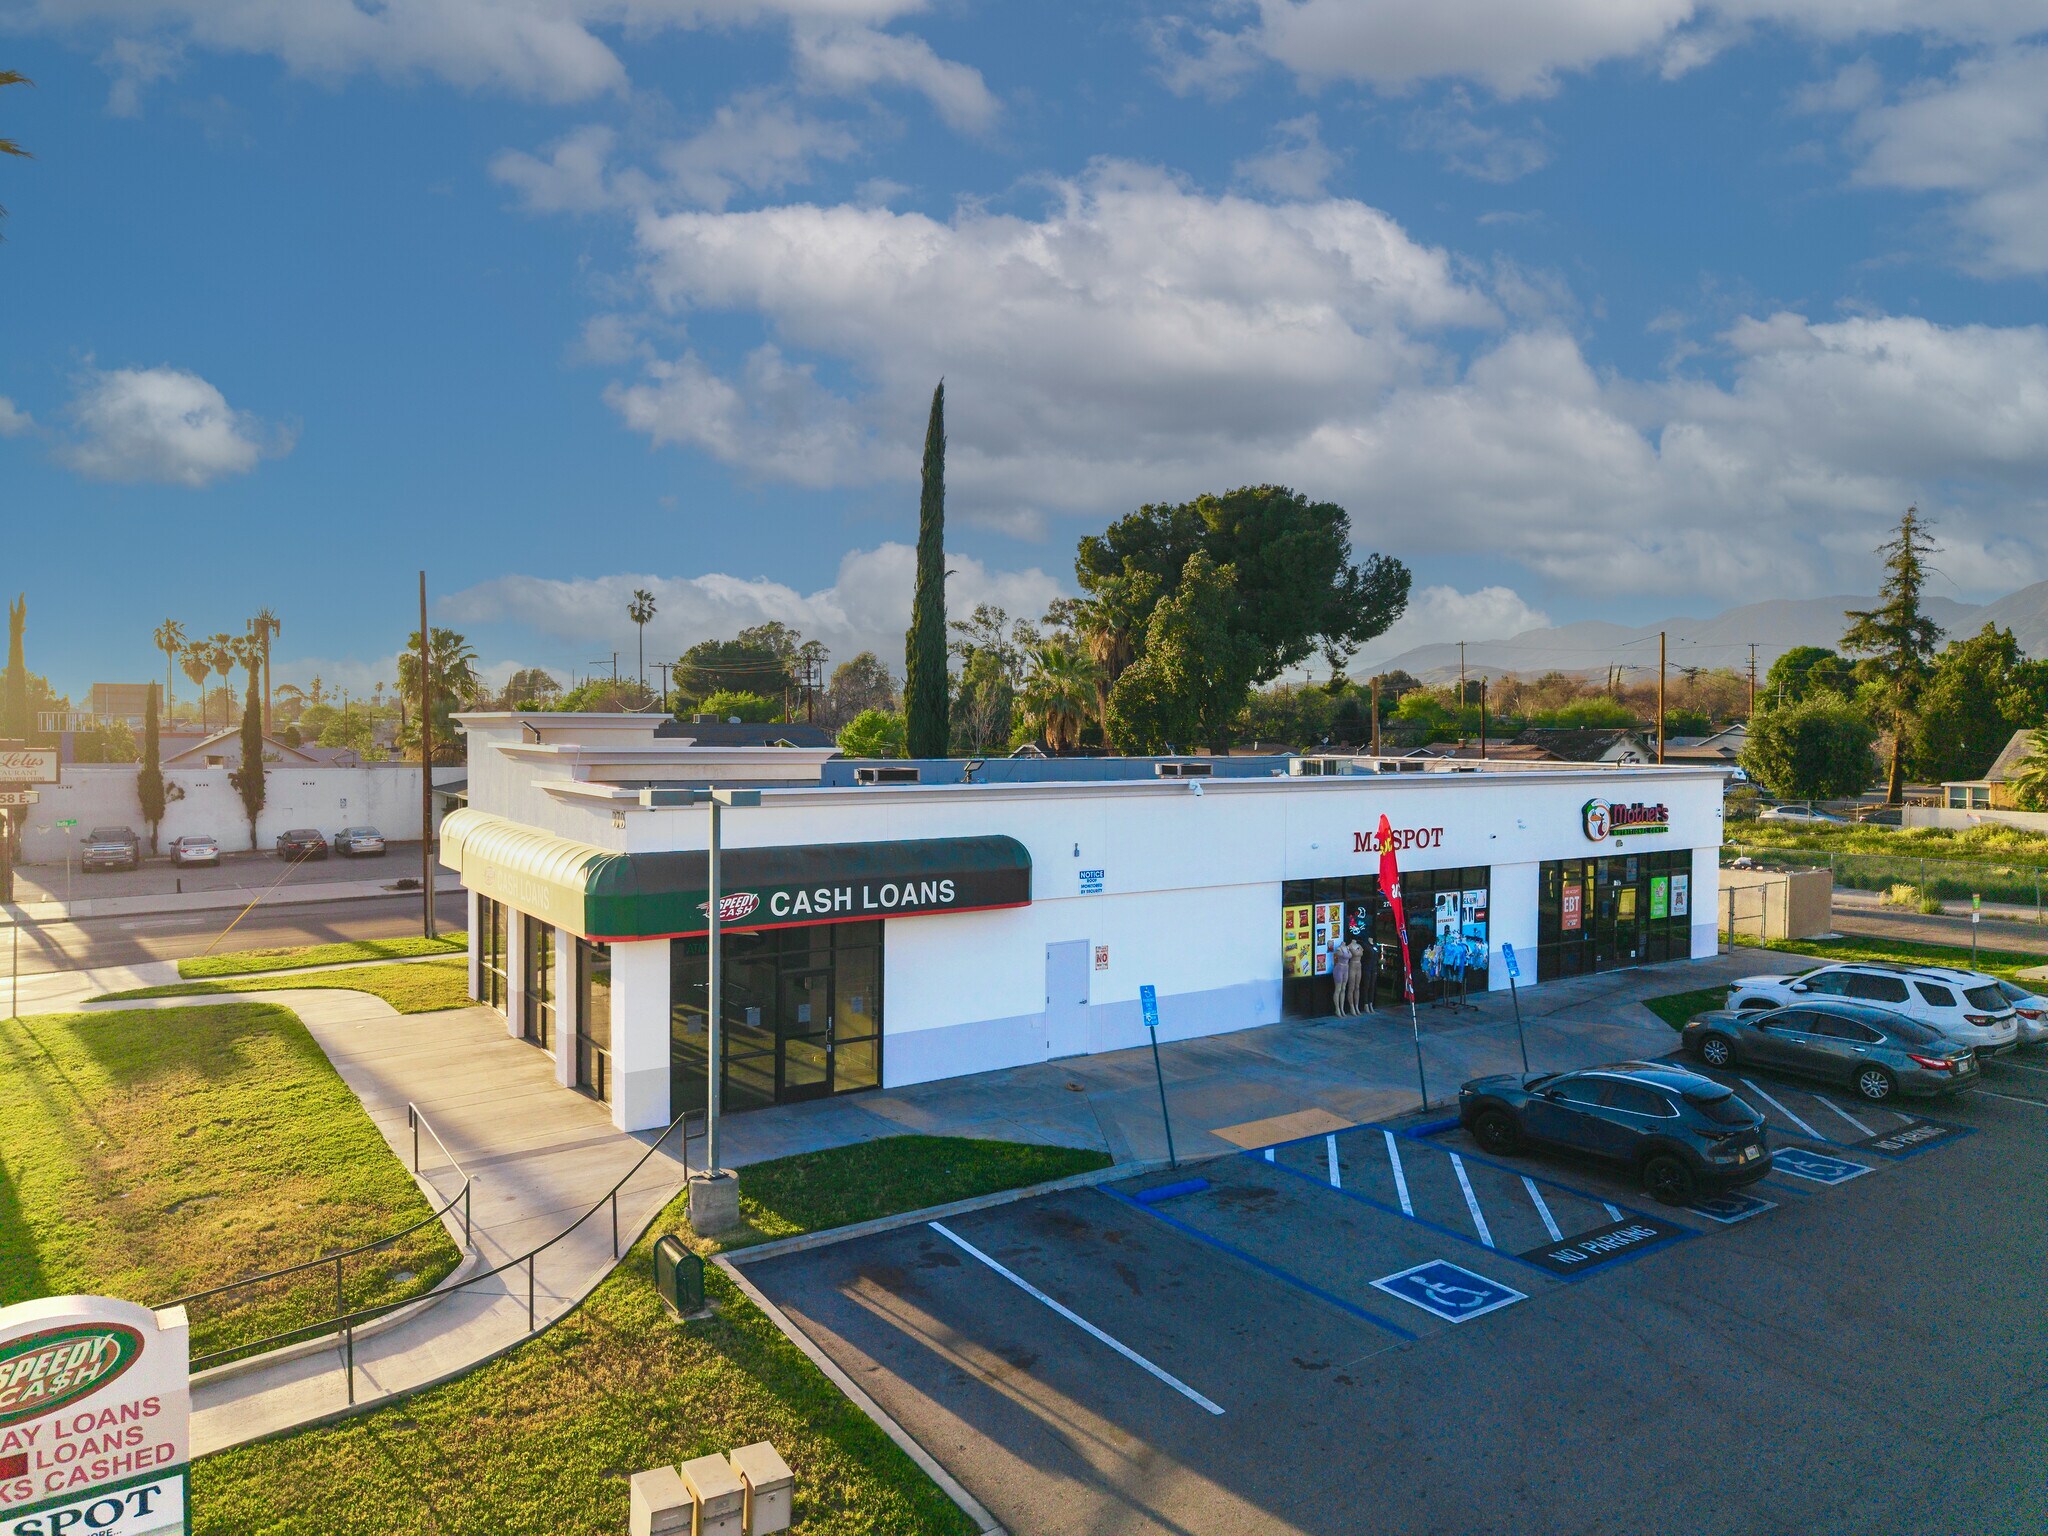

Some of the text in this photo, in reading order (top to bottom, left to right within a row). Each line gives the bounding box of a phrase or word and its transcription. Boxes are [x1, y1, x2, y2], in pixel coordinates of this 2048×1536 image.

[0, 752, 44, 769] Lotus
[1392, 827, 1444, 851] SPOT
[1080, 870, 1104, 879] NOTICE
[520, 876, 551, 910] LOANS
[718, 892, 759, 911] SPEEDY
[770, 879, 956, 917] CASH LOANS
[1564, 896, 1580, 913] EBT
[1096, 953, 1108, 963] NO
[1548, 1224, 1658, 1265] NO PARKING
[0, 1333, 115, 1389] SPEEDY
[55, 1396, 161, 1440] LOANS
[36, 1426, 144, 1470] LOANS
[44, 1442, 175, 1492] CASHED
